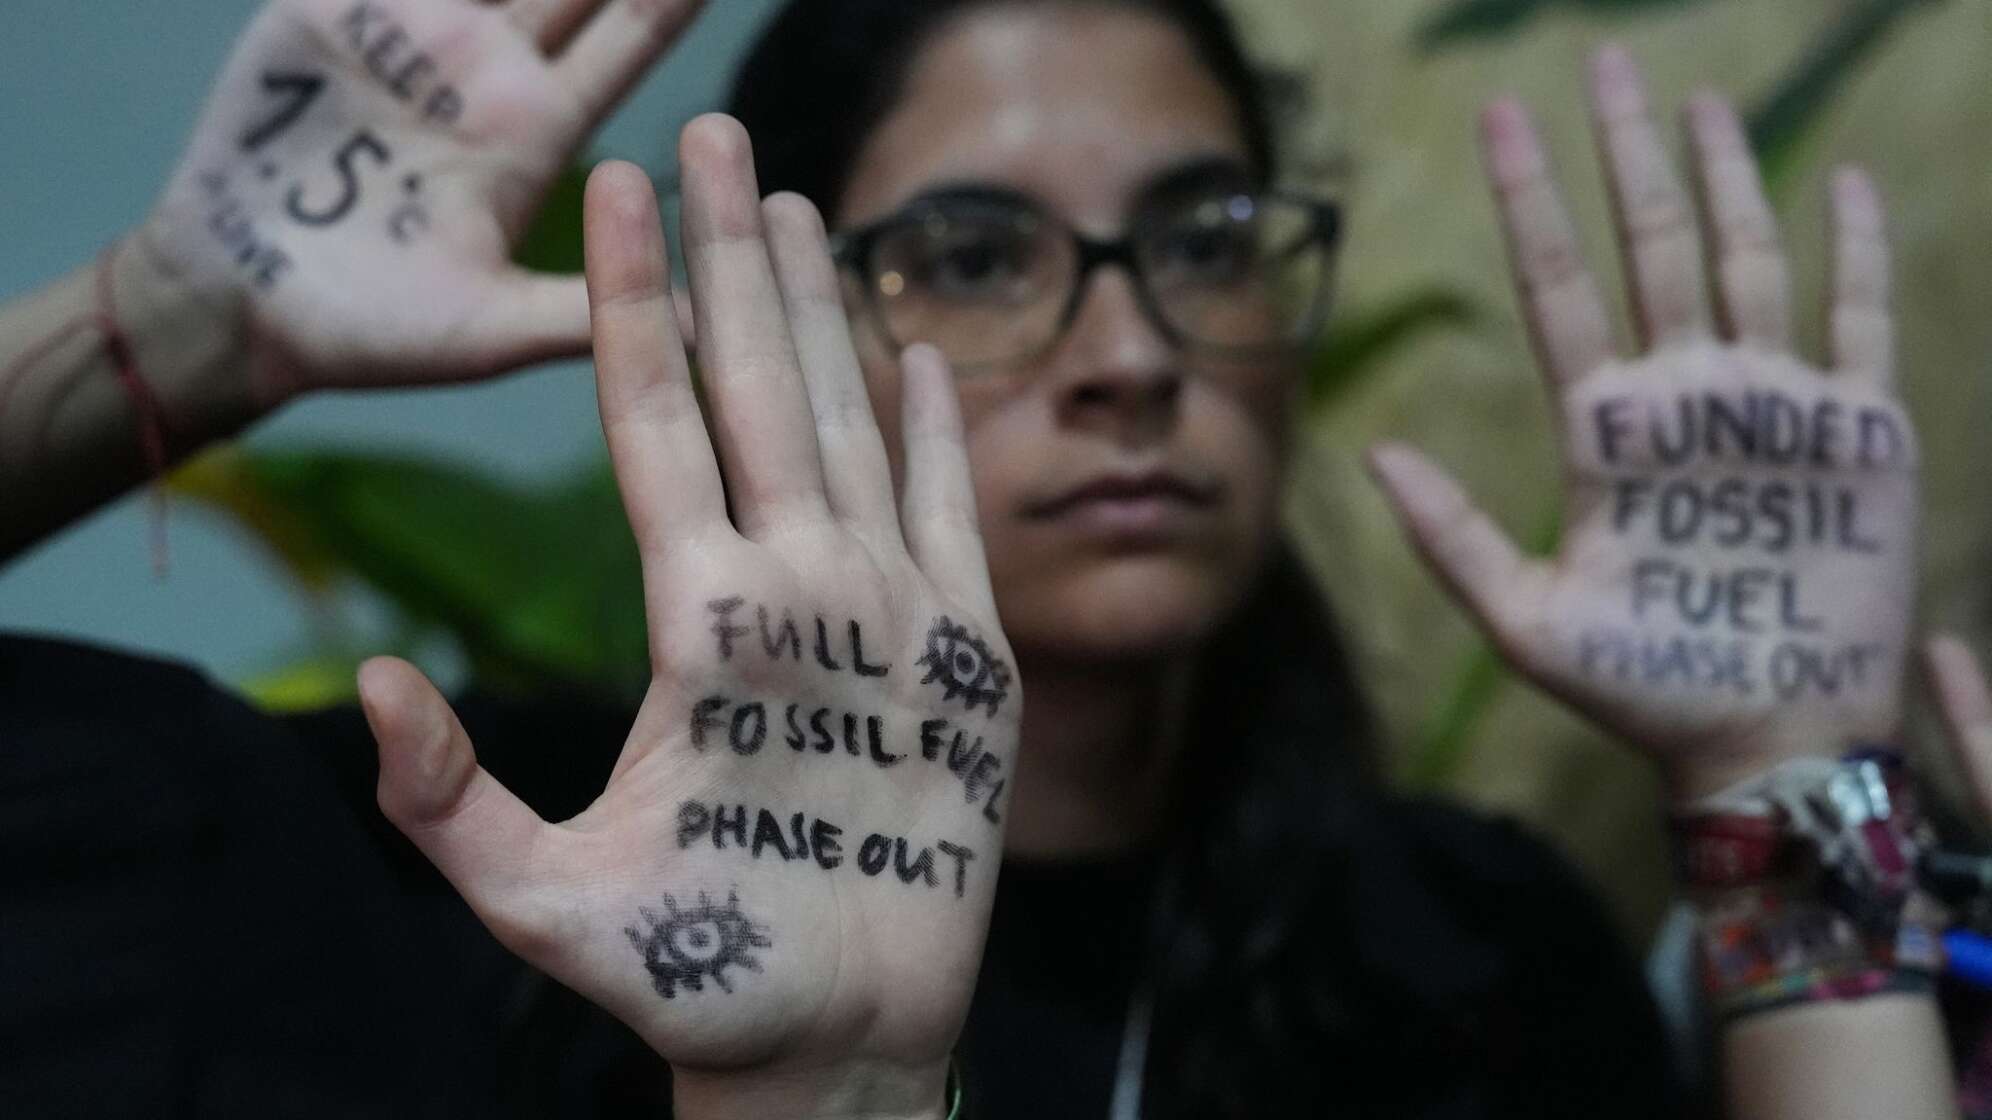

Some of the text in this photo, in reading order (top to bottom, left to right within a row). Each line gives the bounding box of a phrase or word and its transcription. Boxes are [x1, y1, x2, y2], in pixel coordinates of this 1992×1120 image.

[342, 1, 465, 126] KEEP
[1593, 386, 1906, 469] FUNDED
[1611, 477, 1882, 554] FOSSIL
[1631, 557, 1823, 632] FUEL
[707, 597, 893, 677] FULL
[1769, 641, 1886, 701] OUT
[690, 695, 1006, 825] FOSSIL FUEL
[677, 800, 977, 899] PHASE OUT
